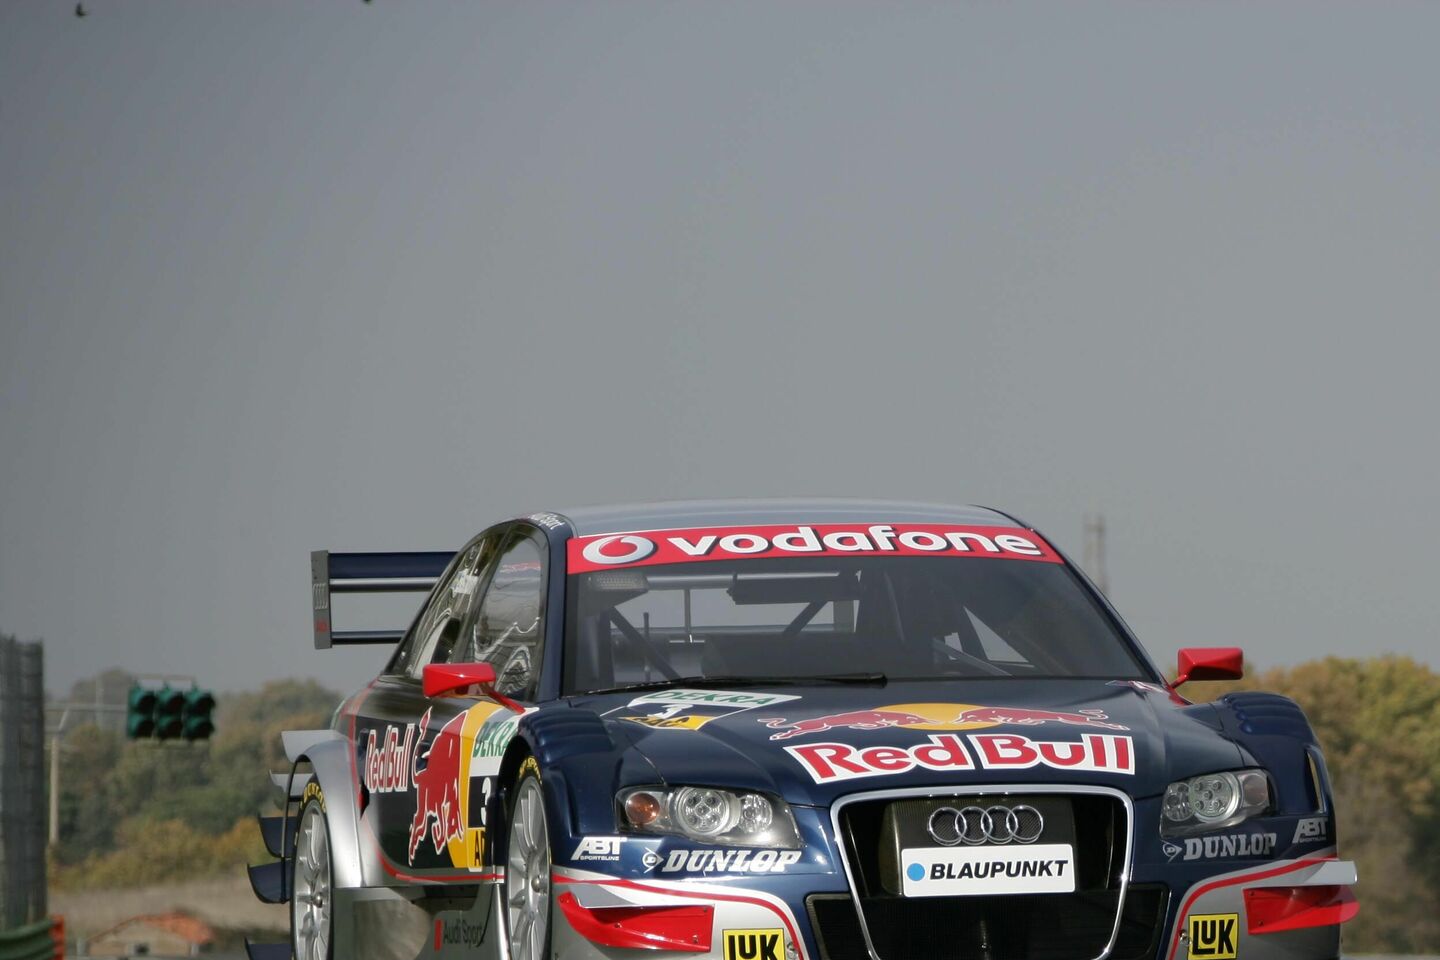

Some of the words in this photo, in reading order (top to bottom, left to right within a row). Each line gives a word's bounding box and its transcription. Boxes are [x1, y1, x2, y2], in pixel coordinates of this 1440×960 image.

[667, 525, 1042, 556] vodafone
[644, 692, 776, 705] DEKRA
[473, 721, 516, 757] DEKR
[366, 724, 391, 793] Red
[386, 722, 415, 793] Bull
[788, 734, 972, 783] Red
[972, 734, 1133, 773] Bull
[1292, 817, 1328, 844] ABT
[570, 836, 627, 861] ABT
[1183, 832, 1278, 861] DUNLOP
[661, 849, 802, 873] DUNLOP
[929, 859, 1069, 881] BLAUPUNKT
[443, 919, 461, 944] Audi
